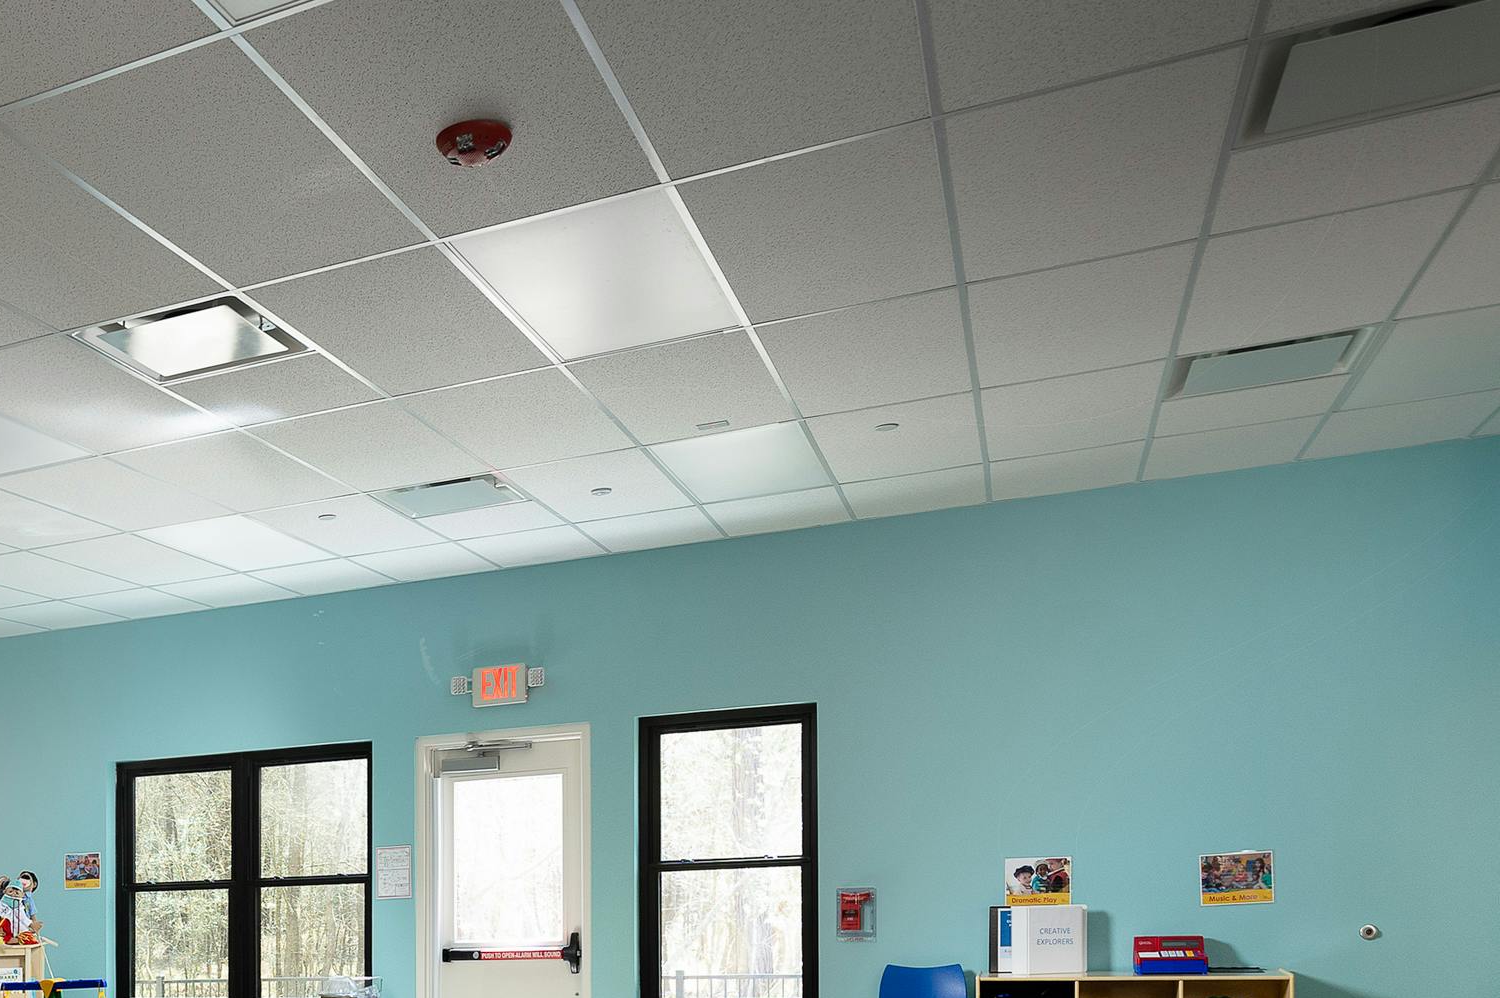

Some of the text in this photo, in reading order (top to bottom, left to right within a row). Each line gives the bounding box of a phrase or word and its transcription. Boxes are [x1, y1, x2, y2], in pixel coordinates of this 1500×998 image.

[480, 664, 519, 701] EXIT
[1011, 894, 1058, 904] Dramatic Play
[1208, 893, 1230, 902] Music
[1238, 892, 1258, 901] More
[1039, 927, 1071, 935] CREATIVE
[1036, 938, 1074, 946] EXPLORERS
